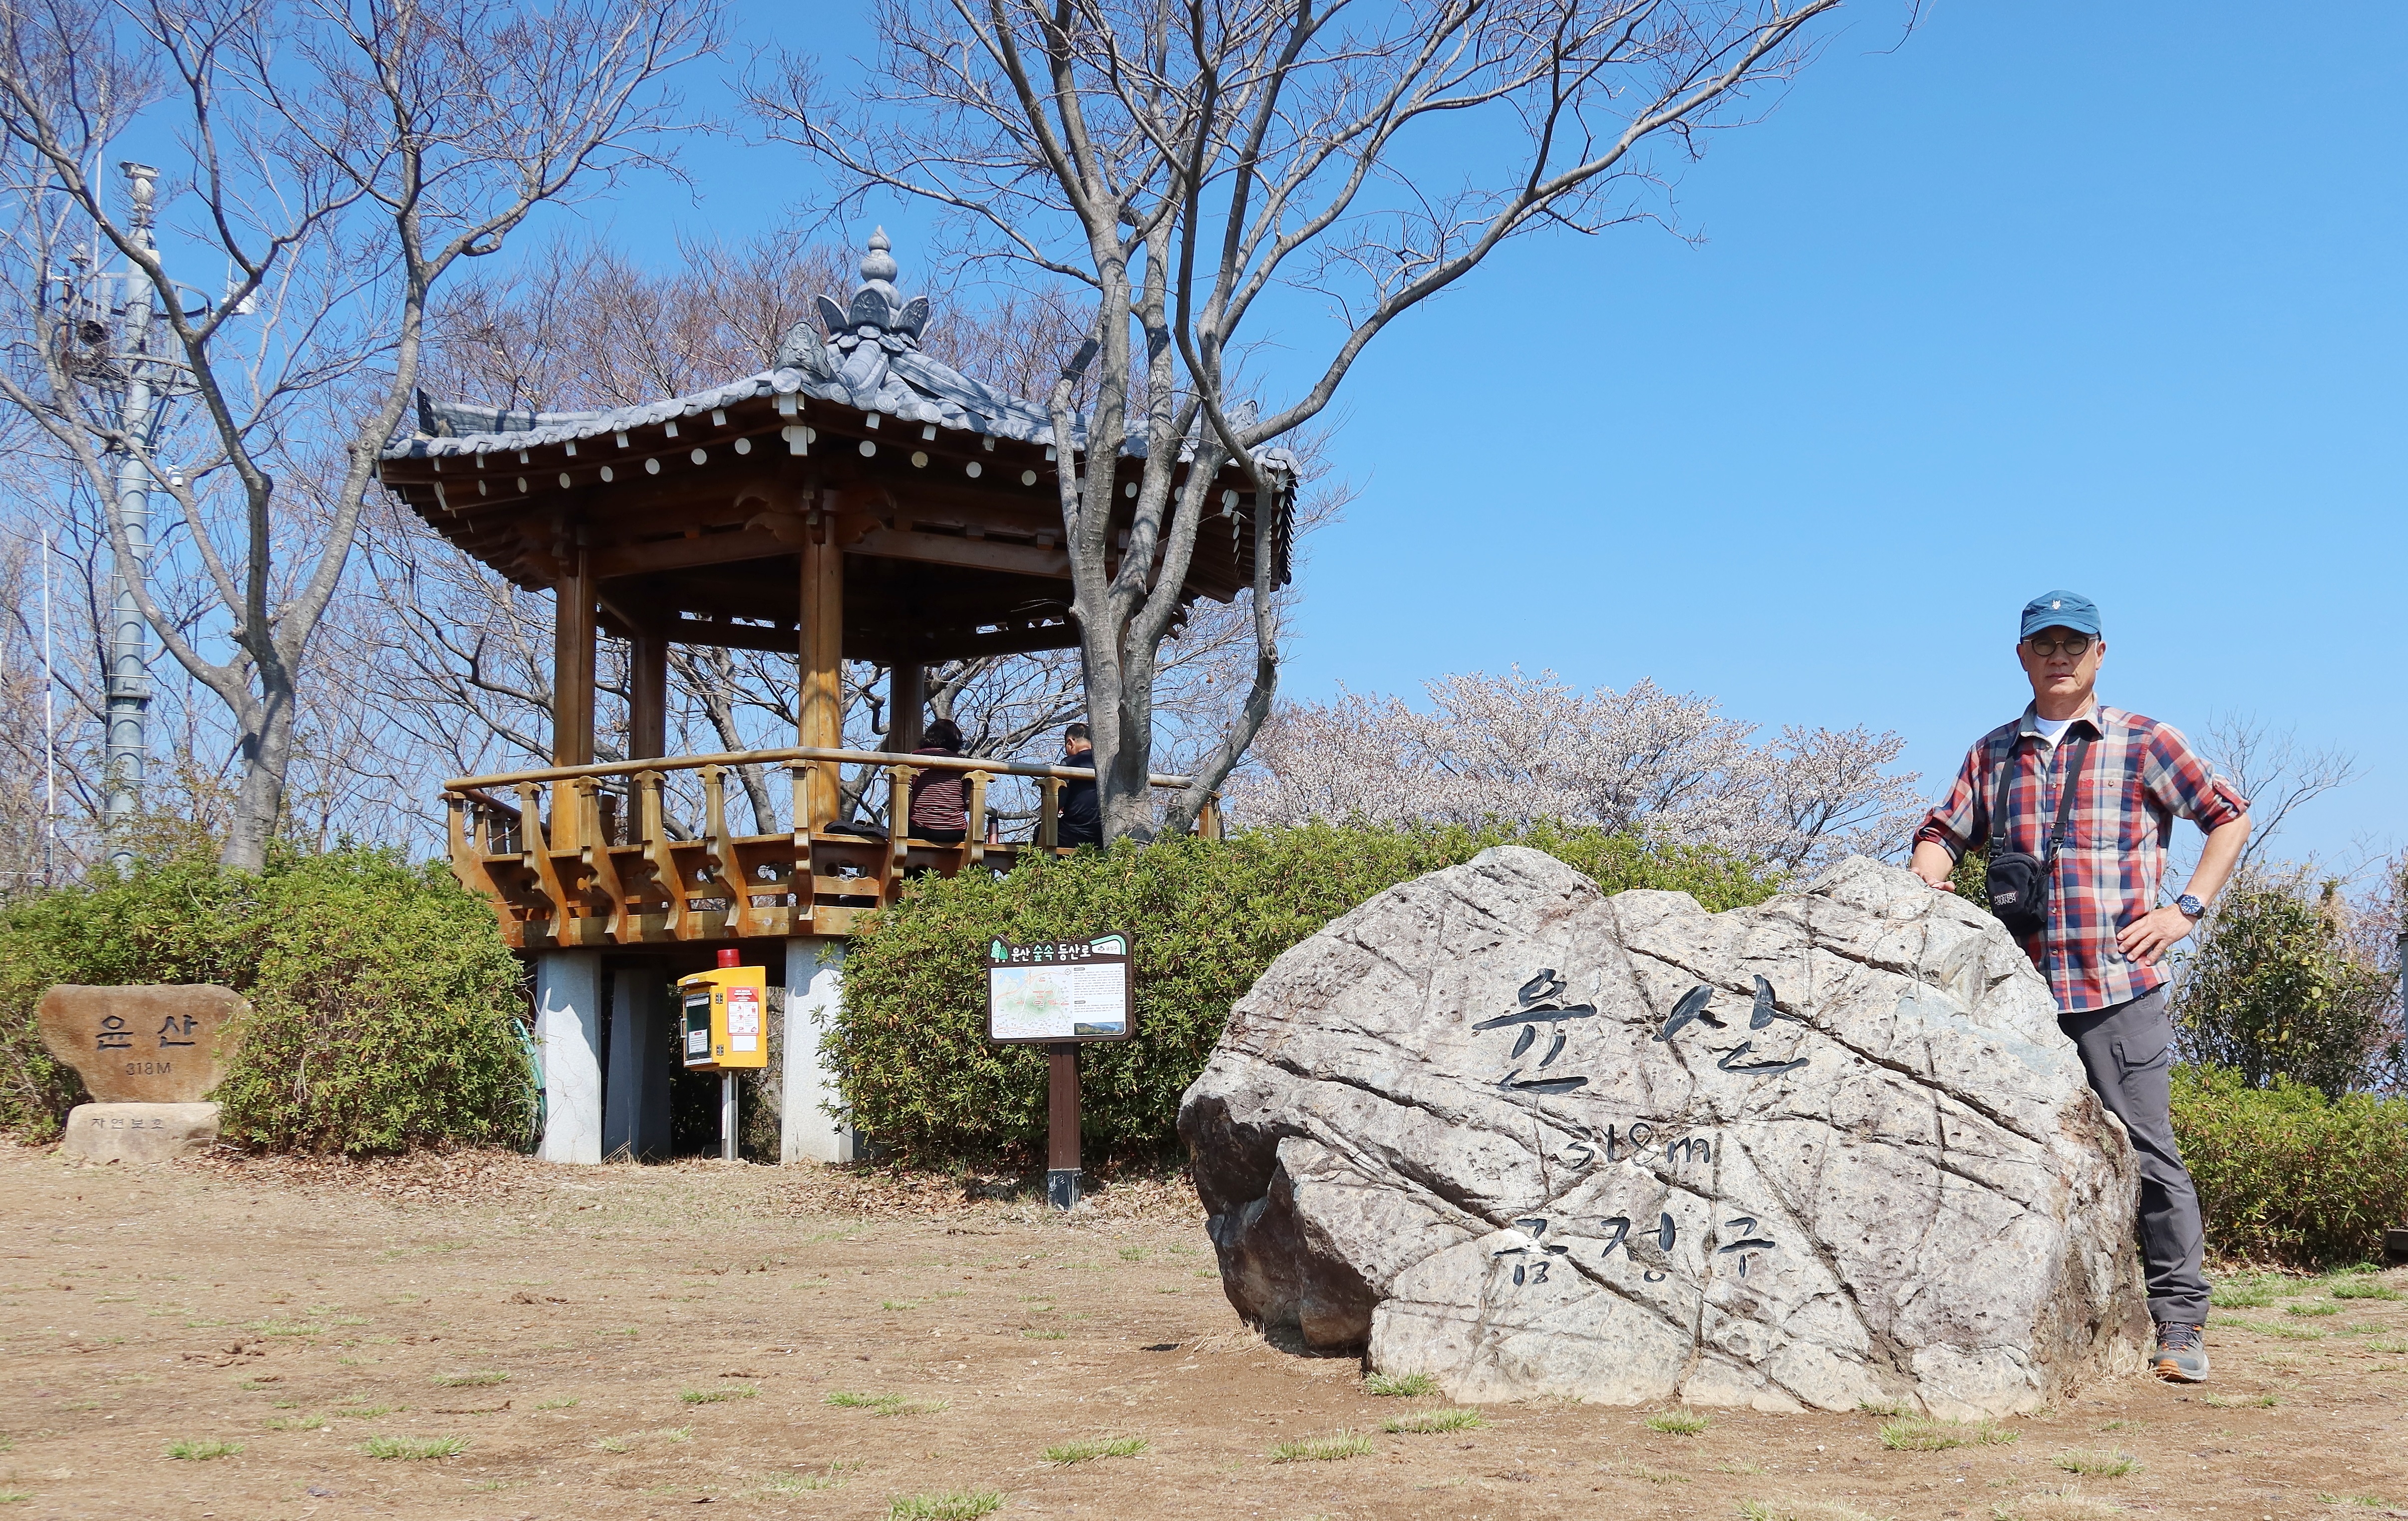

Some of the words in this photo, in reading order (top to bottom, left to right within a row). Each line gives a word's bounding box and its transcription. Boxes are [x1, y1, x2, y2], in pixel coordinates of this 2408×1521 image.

[1994, 891, 2017, 902] MYSTERY
[1011, 947, 1031, 963] 윤산
[1033, 944, 1054, 962] 숲속
[1057, 944, 1091, 961] 등산로
[126, 1062, 171, 1076] 318M
[91, 1117, 165, 1130] 자연보호
[1565, 1122, 1711, 1170] 318m
[1492, 1212, 1776, 1286] 금정구
